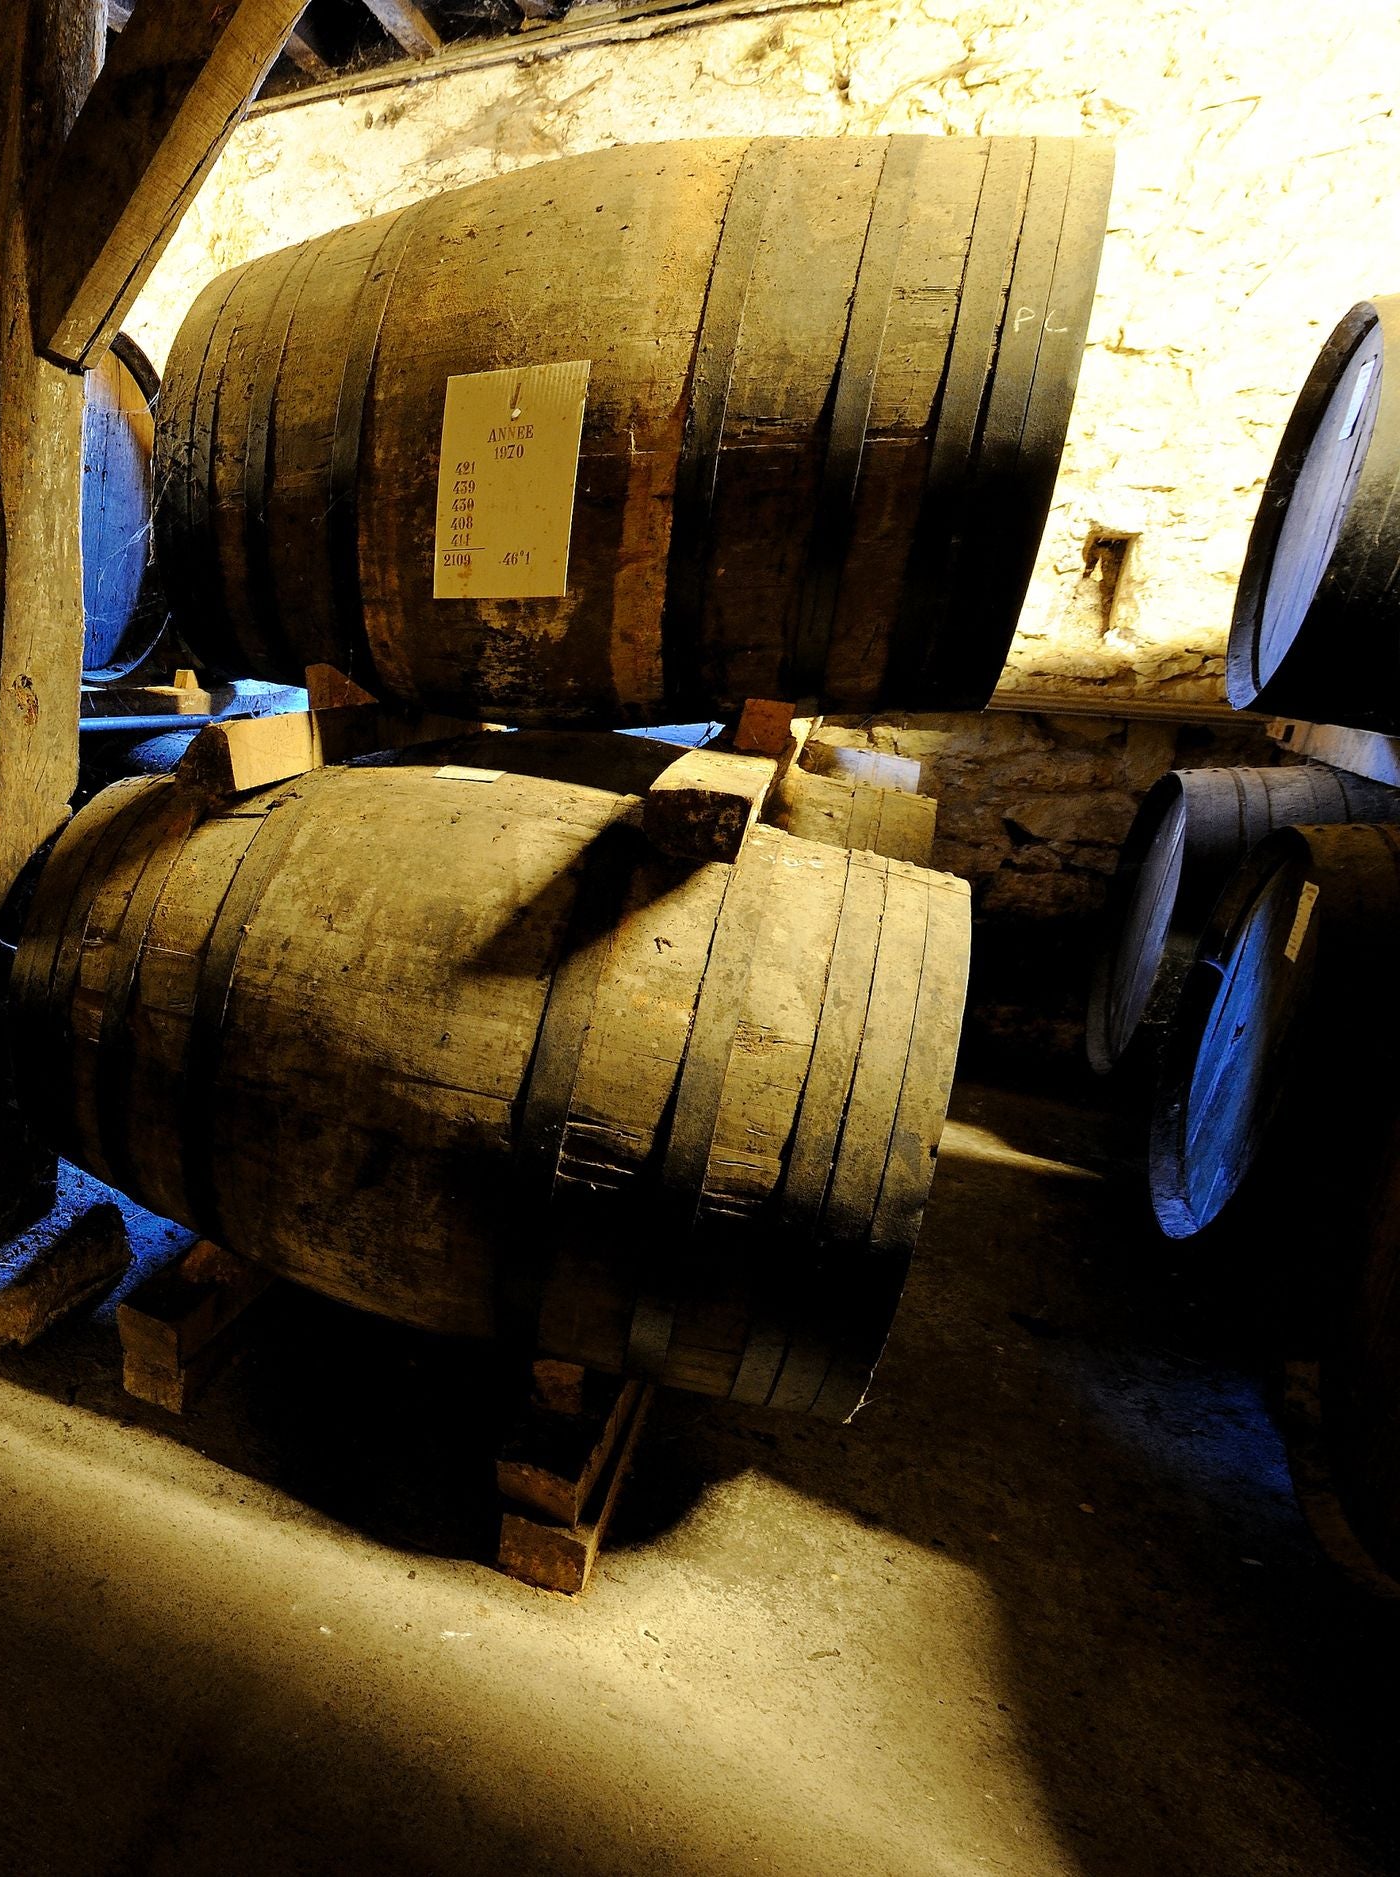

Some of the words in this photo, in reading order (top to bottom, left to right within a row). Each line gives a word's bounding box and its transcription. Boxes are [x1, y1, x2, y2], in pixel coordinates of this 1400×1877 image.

[487, 424, 534, 443] ANNEE
[494, 444, 524, 459] 1970
[455, 461, 475, 475] 421
[453, 480, 476, 495] 439
[451, 497, 475, 512] 430
[450, 515, 473, 530] 408
[443, 553, 472, 567] 2109
